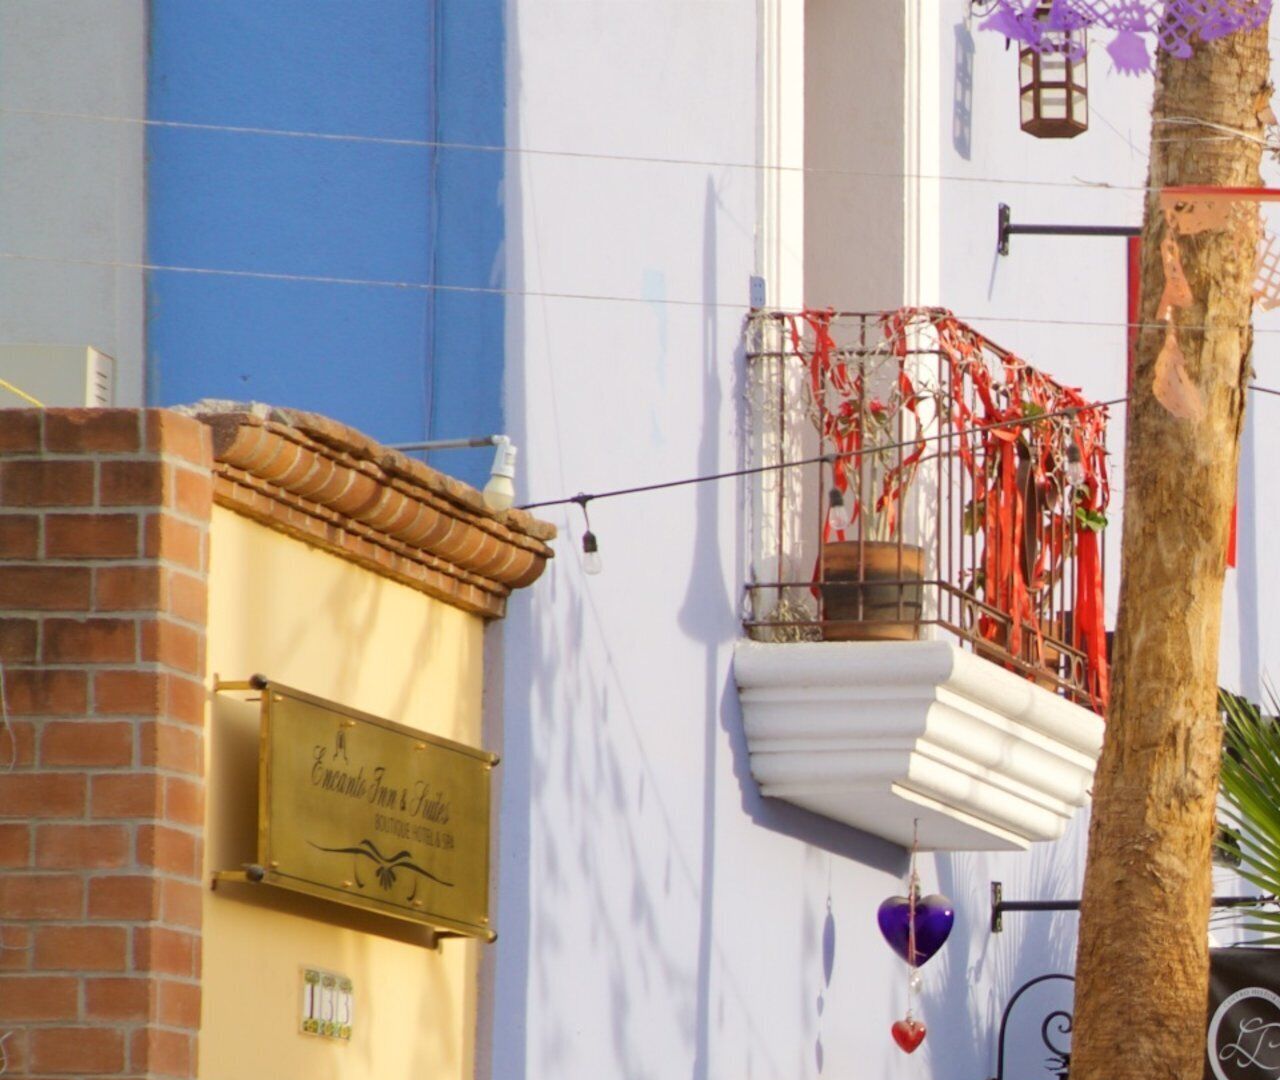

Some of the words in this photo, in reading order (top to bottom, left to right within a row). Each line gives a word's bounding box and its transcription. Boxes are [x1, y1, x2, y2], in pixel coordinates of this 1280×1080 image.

[311, 745, 366, 798] Encanto
[368, 766, 397, 809] Inn
[400, 788, 408, 811] &
[411, 780, 450, 825] Suites
[374, 813, 411, 840] BOUTIQUE
[412, 824, 433, 847] HOTEL
[442, 831, 455, 849] SPA
